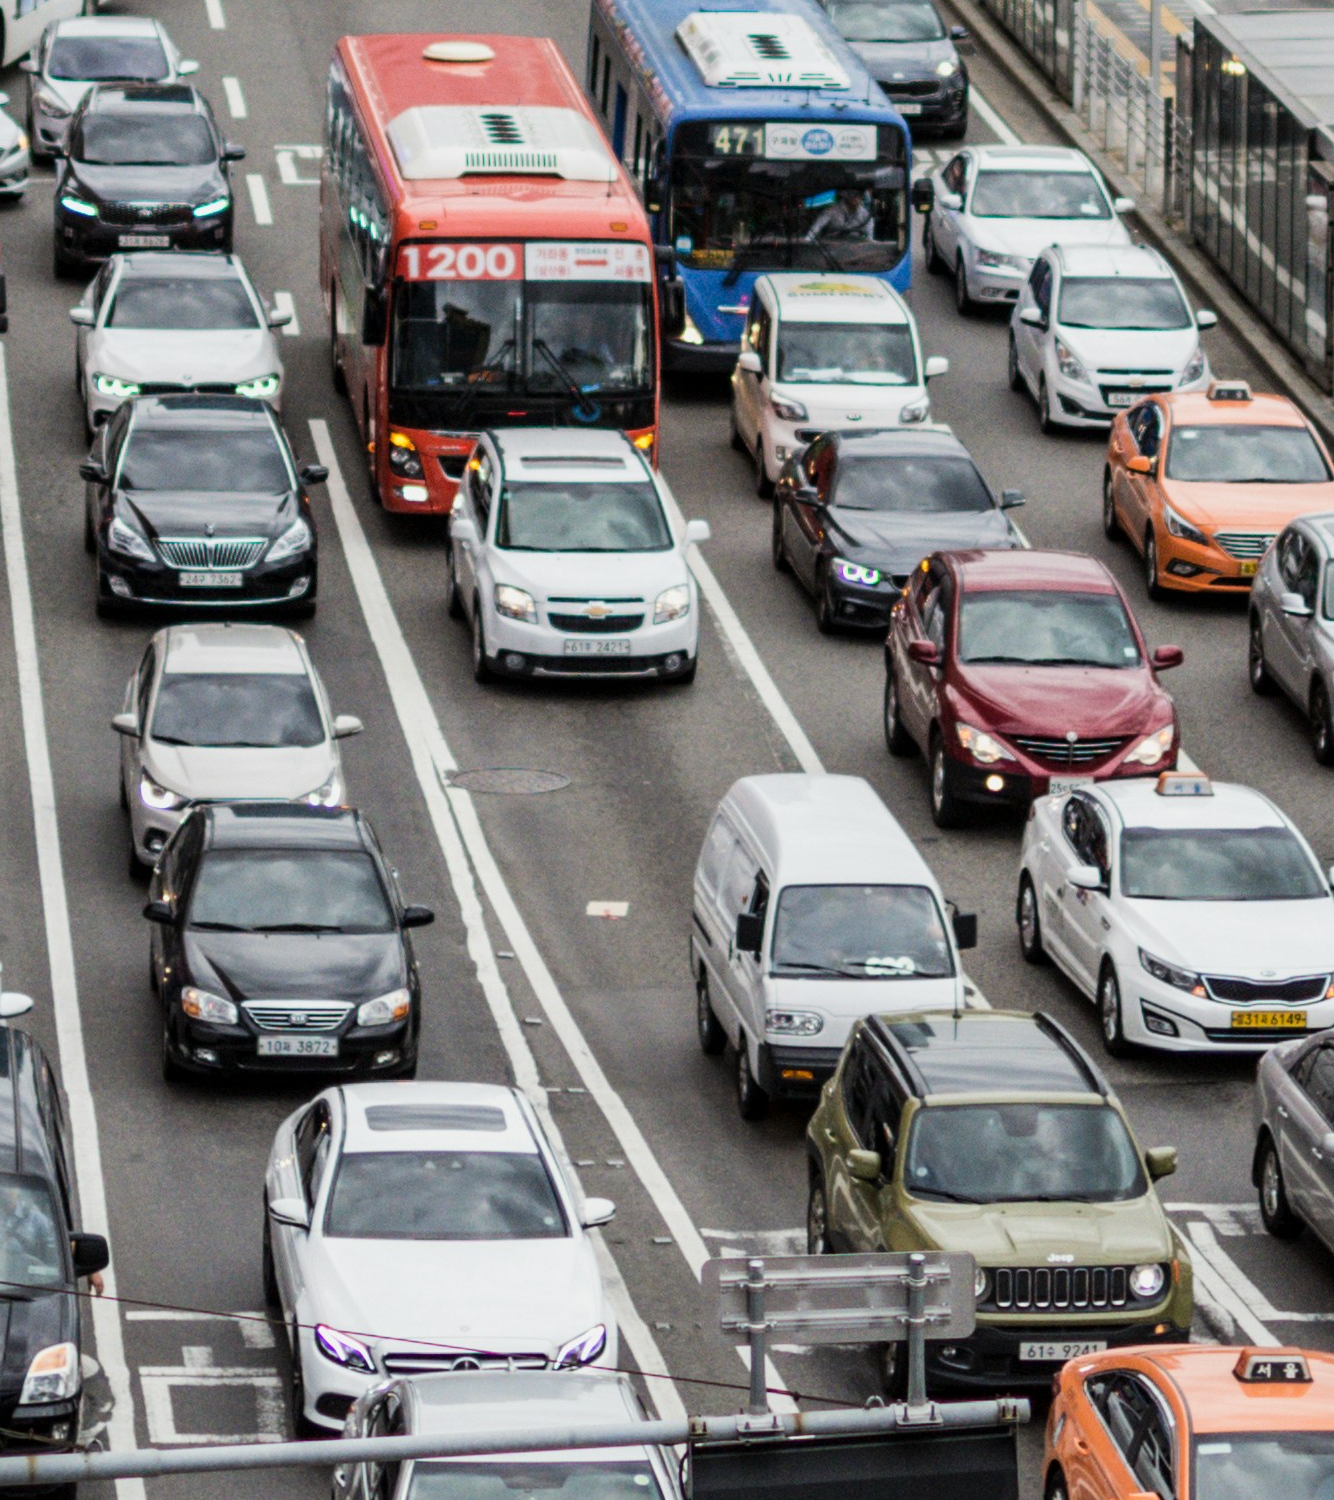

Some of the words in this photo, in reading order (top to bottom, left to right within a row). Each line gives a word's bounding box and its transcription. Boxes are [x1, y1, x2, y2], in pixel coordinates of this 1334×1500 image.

[714, 123, 764, 155] 471
[402, 245, 517, 279] 1200
[595, 641, 622, 652] 2421
[1268, 1012, 1302, 1026] 6149
[297, 1041, 332, 1053] 3872
[1063, 1345, 1097, 1358] 9241
[1257, 1362, 1299, 1379] 서울
